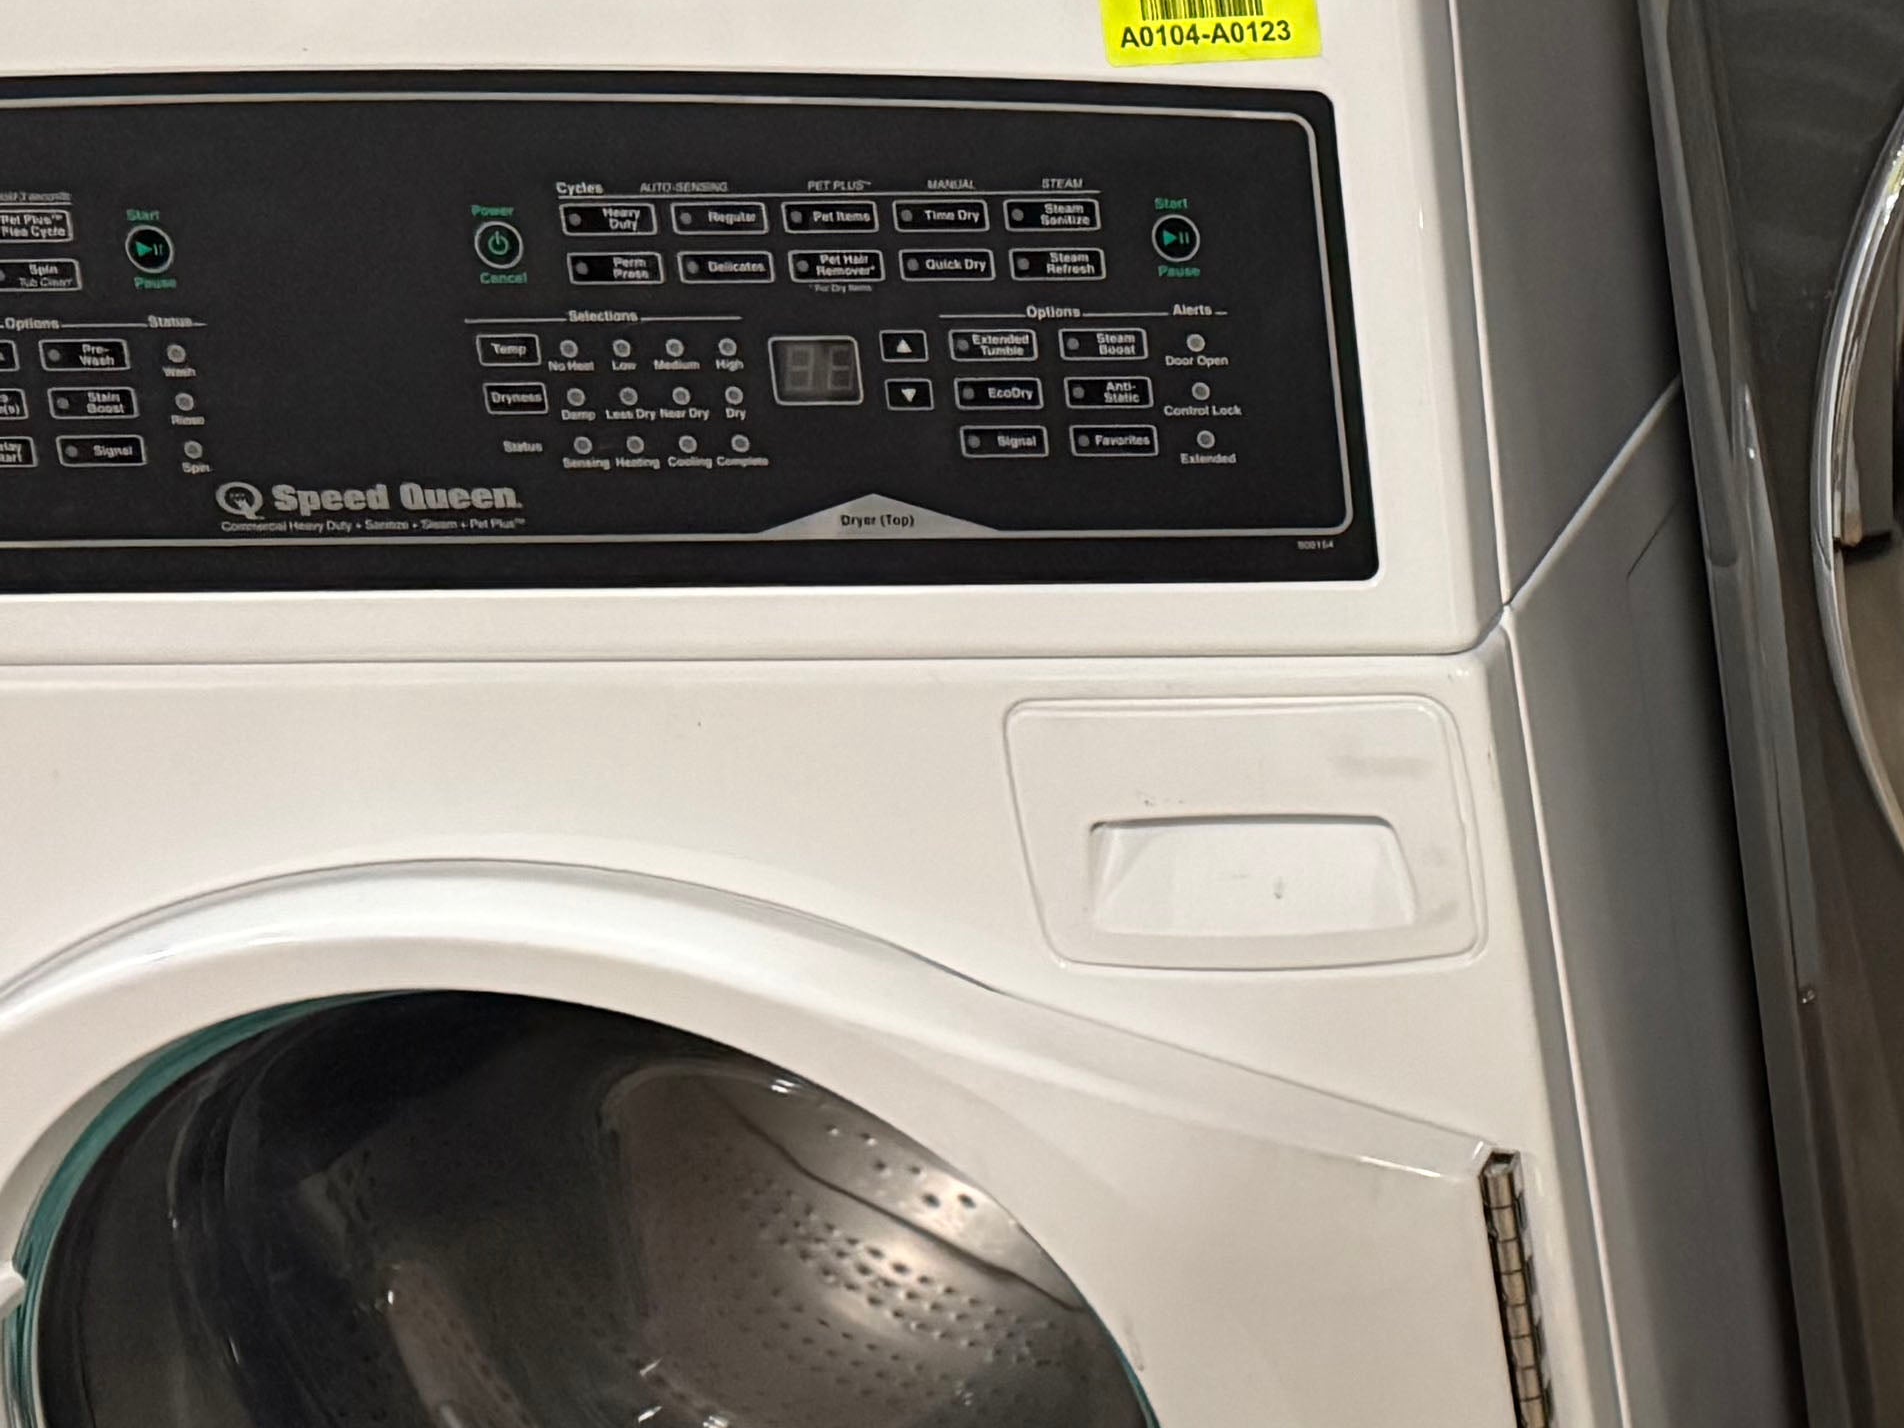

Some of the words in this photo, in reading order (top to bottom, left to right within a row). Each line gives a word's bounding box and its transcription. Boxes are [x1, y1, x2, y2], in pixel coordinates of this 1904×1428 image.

[1120, 20, 1292, 48] A0104-A0123
[556, 182, 603, 195] Cycles
[807, 180, 828, 191] PET
[927, 179, 976, 189] MANUAL
[1042, 178, 1083, 189] STEAM
[1044, 203, 1084, 214] Steam
[1154, 198, 1188, 210] Start
[126, 209, 160, 221] Start
[471, 205, 514, 217] Power
[602, 207, 640, 219] Heavy
[812, 211, 834, 222] Pet
[836, 211, 871, 222] Items
[925, 209, 955, 221] Time
[957, 210, 980, 223] Dry
[708, 211, 756, 225] Regular
[1040, 215, 1090, 226] Sanitize
[609, 219, 638, 232] Duty
[31, 226, 66, 239] Cycle
[612, 257, 647, 267] Perm
[819, 255, 840, 265] Pet
[843, 255, 868, 264] Hair
[1050, 252, 1089, 263] Steam
[29, 264, 58, 276] Spin
[708, 261, 766, 272] Delicates
[925, 258, 962, 270] Quick
[964, 258, 986, 272] Dry
[1046, 263, 1095, 275] Refresh
[612, 267, 650, 279] Press
[1158, 266, 1200, 278] Pause
[134, 277, 177, 289] Pause
[480, 272, 527, 285] Cancel
[568, 310, 638, 322] Selections
[1026, 306, 1081, 320] Options
[1173, 304, 1212, 317] Alerts
[5, 317, 60, 331] Options
[148, 315, 192, 328] Status
[972, 334, 1029, 345] Extended
[1096, 334, 1136, 344] Steam
[82, 344, 109, 354] Pre-
[491, 342, 527, 356] Temp
[980, 345, 1025, 356] Tumble
[1099, 344, 1136, 355] Boost
[79, 355, 114, 366] Wash
[548, 361, 566, 371] No
[567, 360, 595, 371] Heat
[612, 360, 637, 370] Low
[654, 360, 700, 370] Medium
[716, 359, 744, 372] High
[1165, 355, 1194, 366] Door
[1197, 355, 1228, 368] Open
[1106, 381, 1136, 392] Anti-
[87, 392, 120, 403] Stain
[491, 392, 542, 404] Dryness
[988, 387, 1033, 401] EcoDry
[1104, 391, 1140, 404] Static
[86, 403, 124, 413] Boost
[1164, 405, 1209, 416] Control
[1212, 404, 1242, 416] Lock
[561, 410, 596, 421] Damp
[606, 409, 633, 420] Less
[636, 410, 656, 422] Dry
[660, 409, 686, 419] Near
[689, 408, 709, 421] Dry
[725, 408, 746, 421] Dry
[997, 436, 1037, 449] Signal
[1095, 435, 1150, 446] Favorites
[93, 445, 133, 457] Signal
[503, 441, 543, 453] Status
[563, 457, 611, 471] Sensing
[616, 457, 660, 470] Heating
[667, 456, 713, 470] Cooling
[717, 456, 769, 468] Complete
[1180, 453, 1237, 464] Extended
[271, 484, 390, 516] Speed
[400, 482, 517, 510] Queen
[326, 520, 351, 533] Duty
[841, 515, 876, 527] Dryer
[880, 514, 914, 527] (Top)
